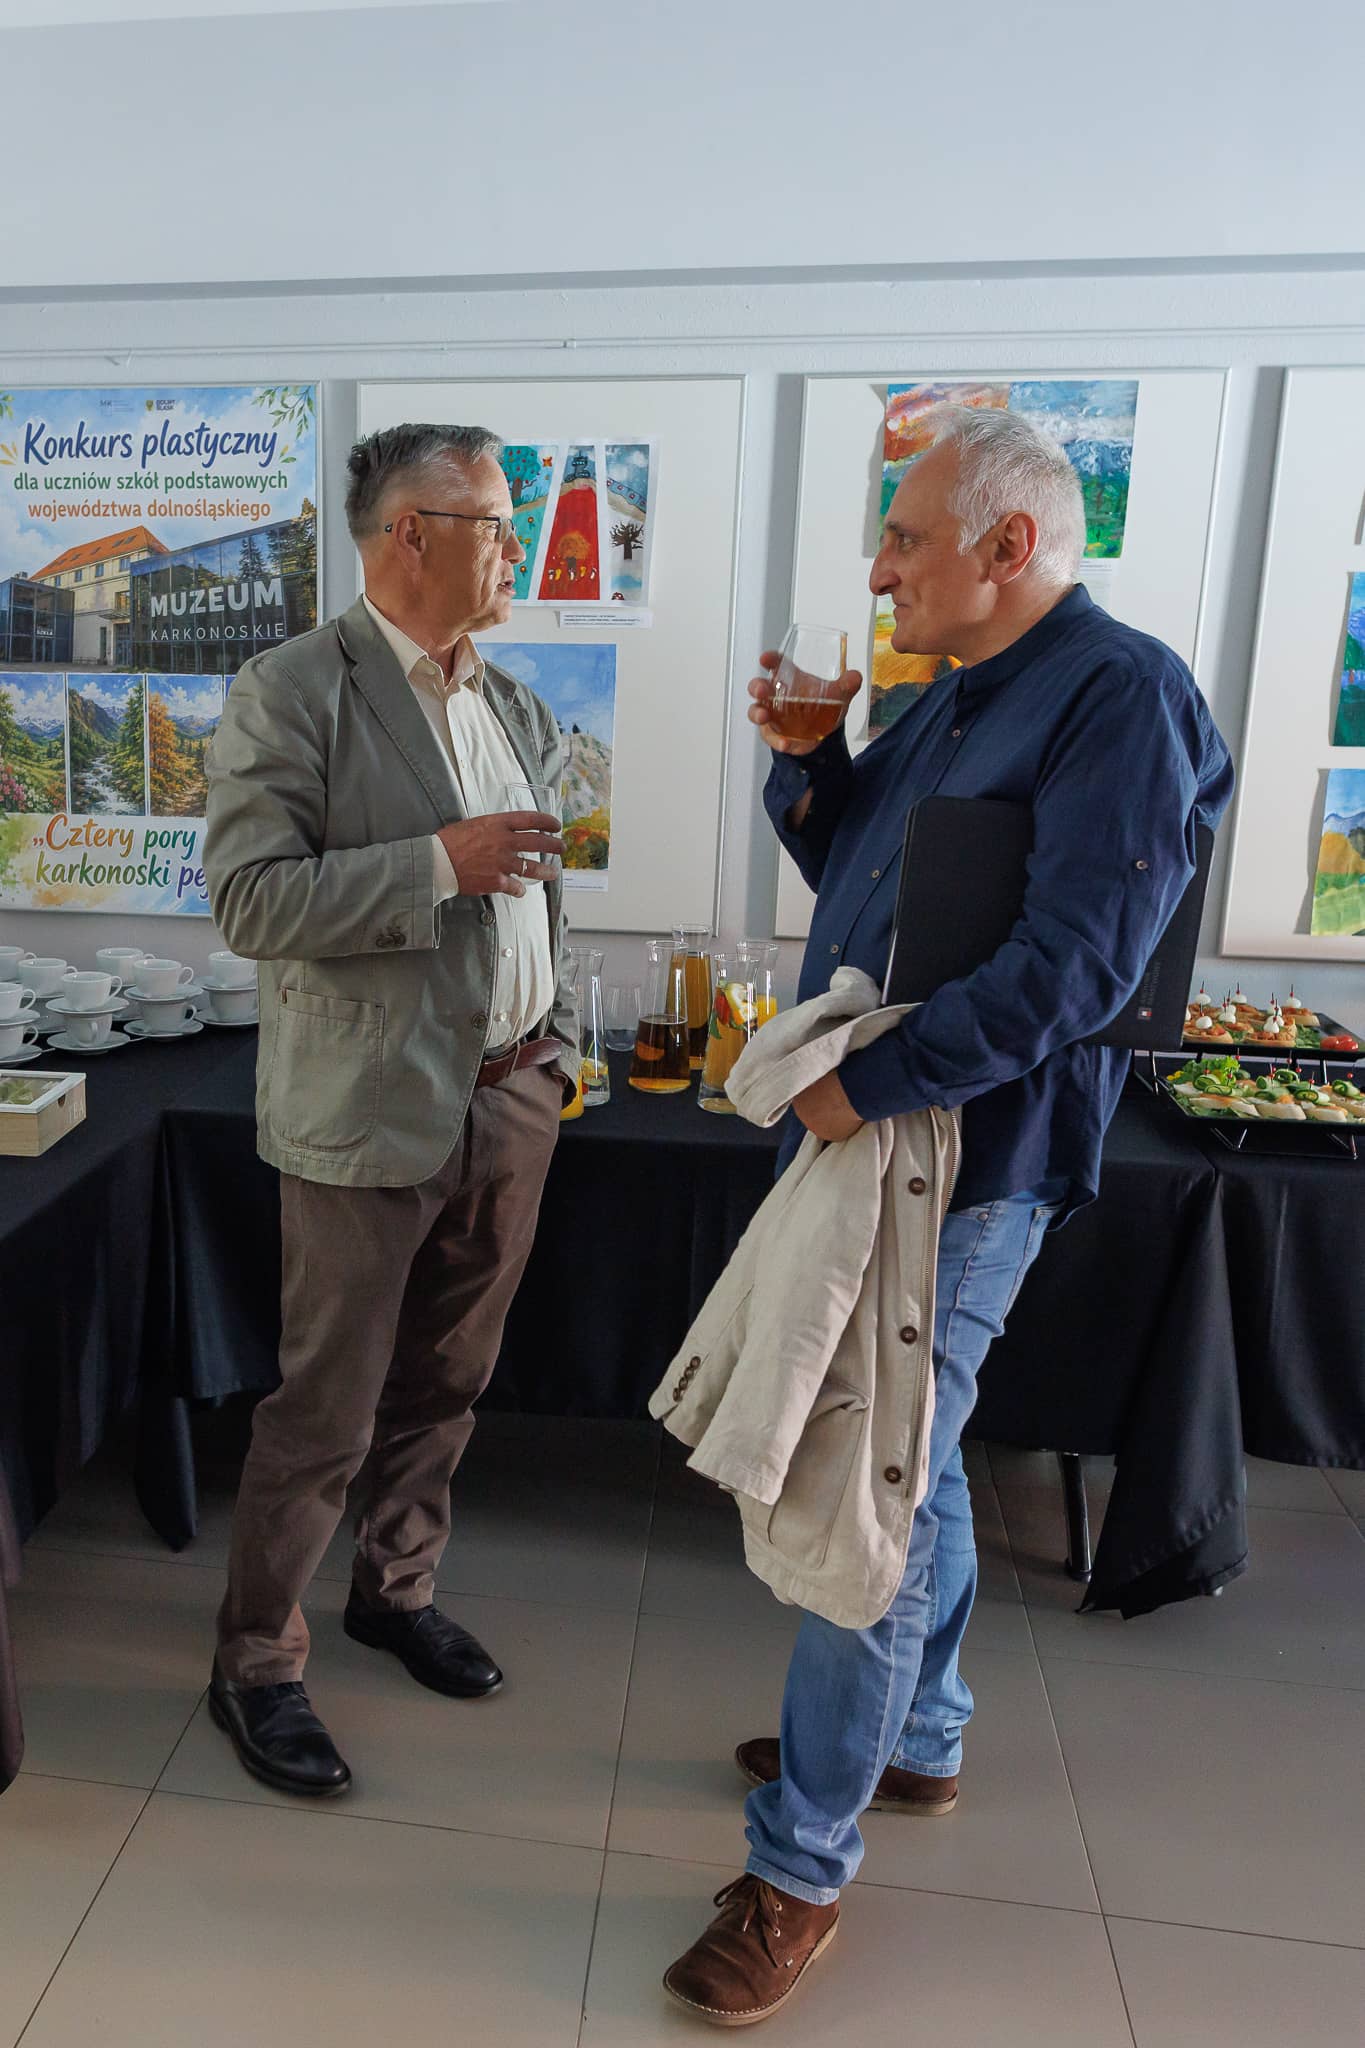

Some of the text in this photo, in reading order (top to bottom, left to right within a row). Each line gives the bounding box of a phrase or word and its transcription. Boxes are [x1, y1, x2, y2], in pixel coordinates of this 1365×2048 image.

[24, 419, 278, 469] Konkurs plastyczny
[14, 471, 288, 494] dla uczniów szkół podstawowych
[28, 499, 271, 522] województwa dolnośląskiego
[151, 578, 283, 618] MUZEUM
[151, 623, 285, 641] KARKONOSKIE
[144, 829, 197, 861] pory
[36, 851, 170, 888] karkonoski
